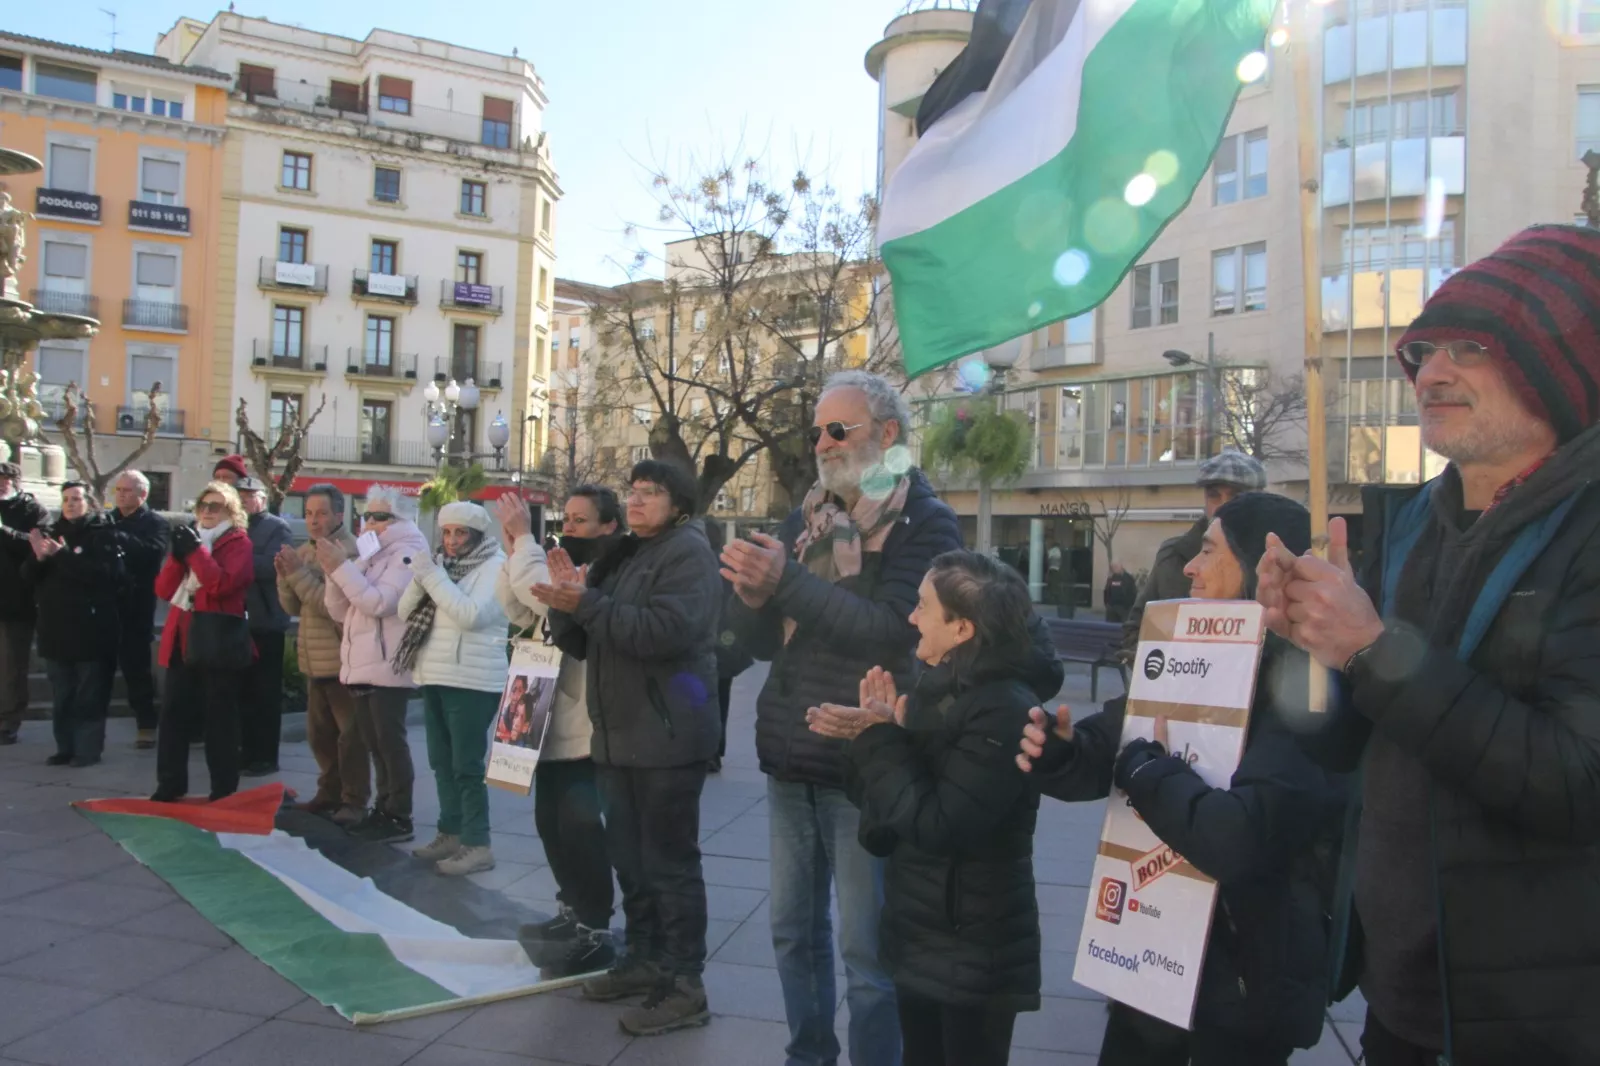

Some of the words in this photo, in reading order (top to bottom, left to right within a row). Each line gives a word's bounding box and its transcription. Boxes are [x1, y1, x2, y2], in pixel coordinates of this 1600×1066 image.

[1186, 617, 1246, 635] BOICOT
[1166, 657, 1211, 678] Spotify
[1088, 939, 1140, 974] facebook
[1156, 954, 1185, 977] Meta
